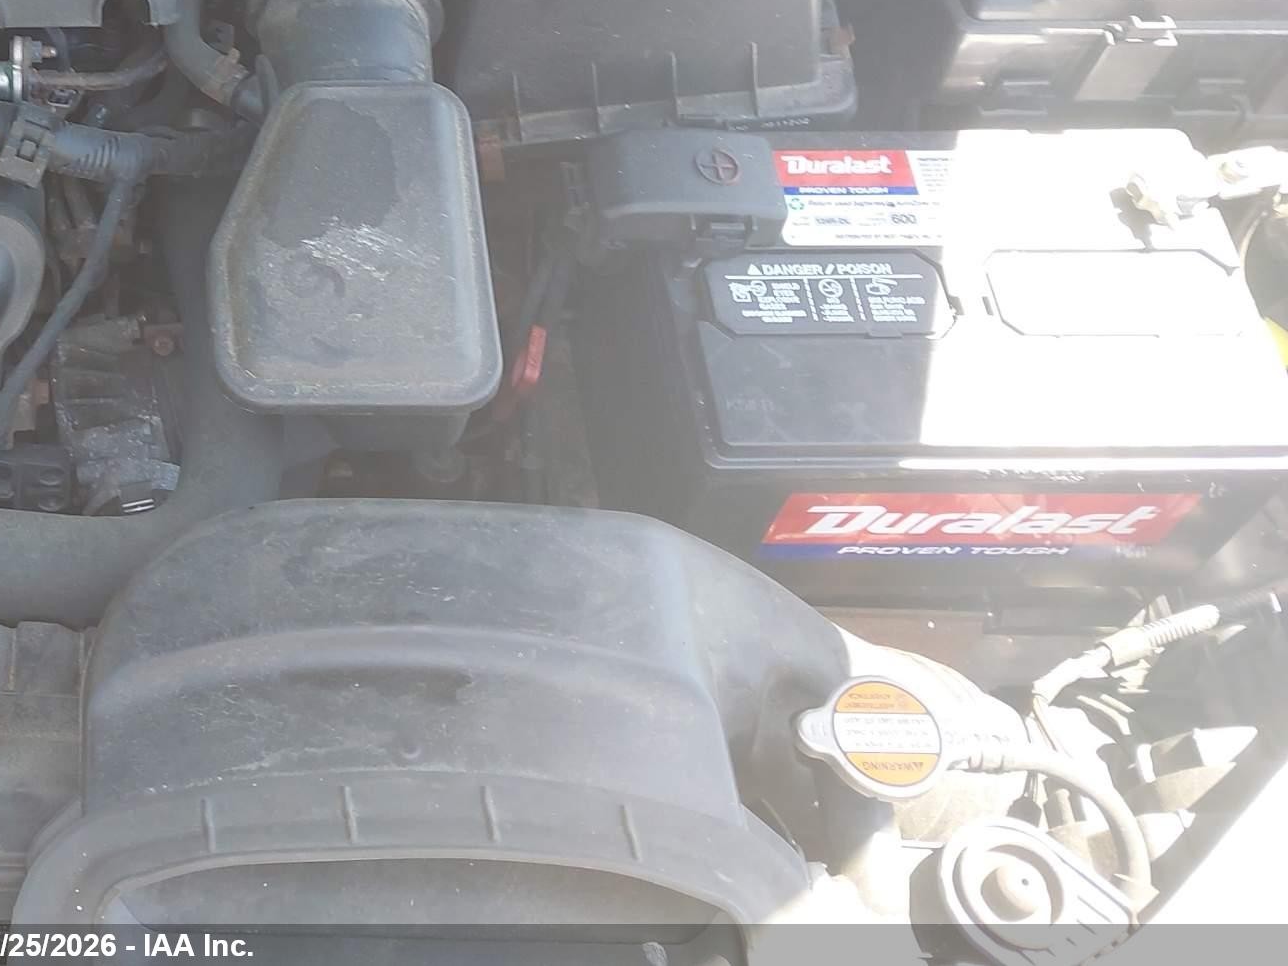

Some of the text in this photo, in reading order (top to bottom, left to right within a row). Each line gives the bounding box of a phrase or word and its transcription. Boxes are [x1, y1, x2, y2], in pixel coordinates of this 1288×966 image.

[780, 155, 893, 174] Duralast
[762, 264, 893, 276] DANGER / POISON
[805, 505, 1161, 535] Duralast
[836, 546, 1070, 555] PROVEN TOUGH
[862, 761, 914, 771] WARNING
